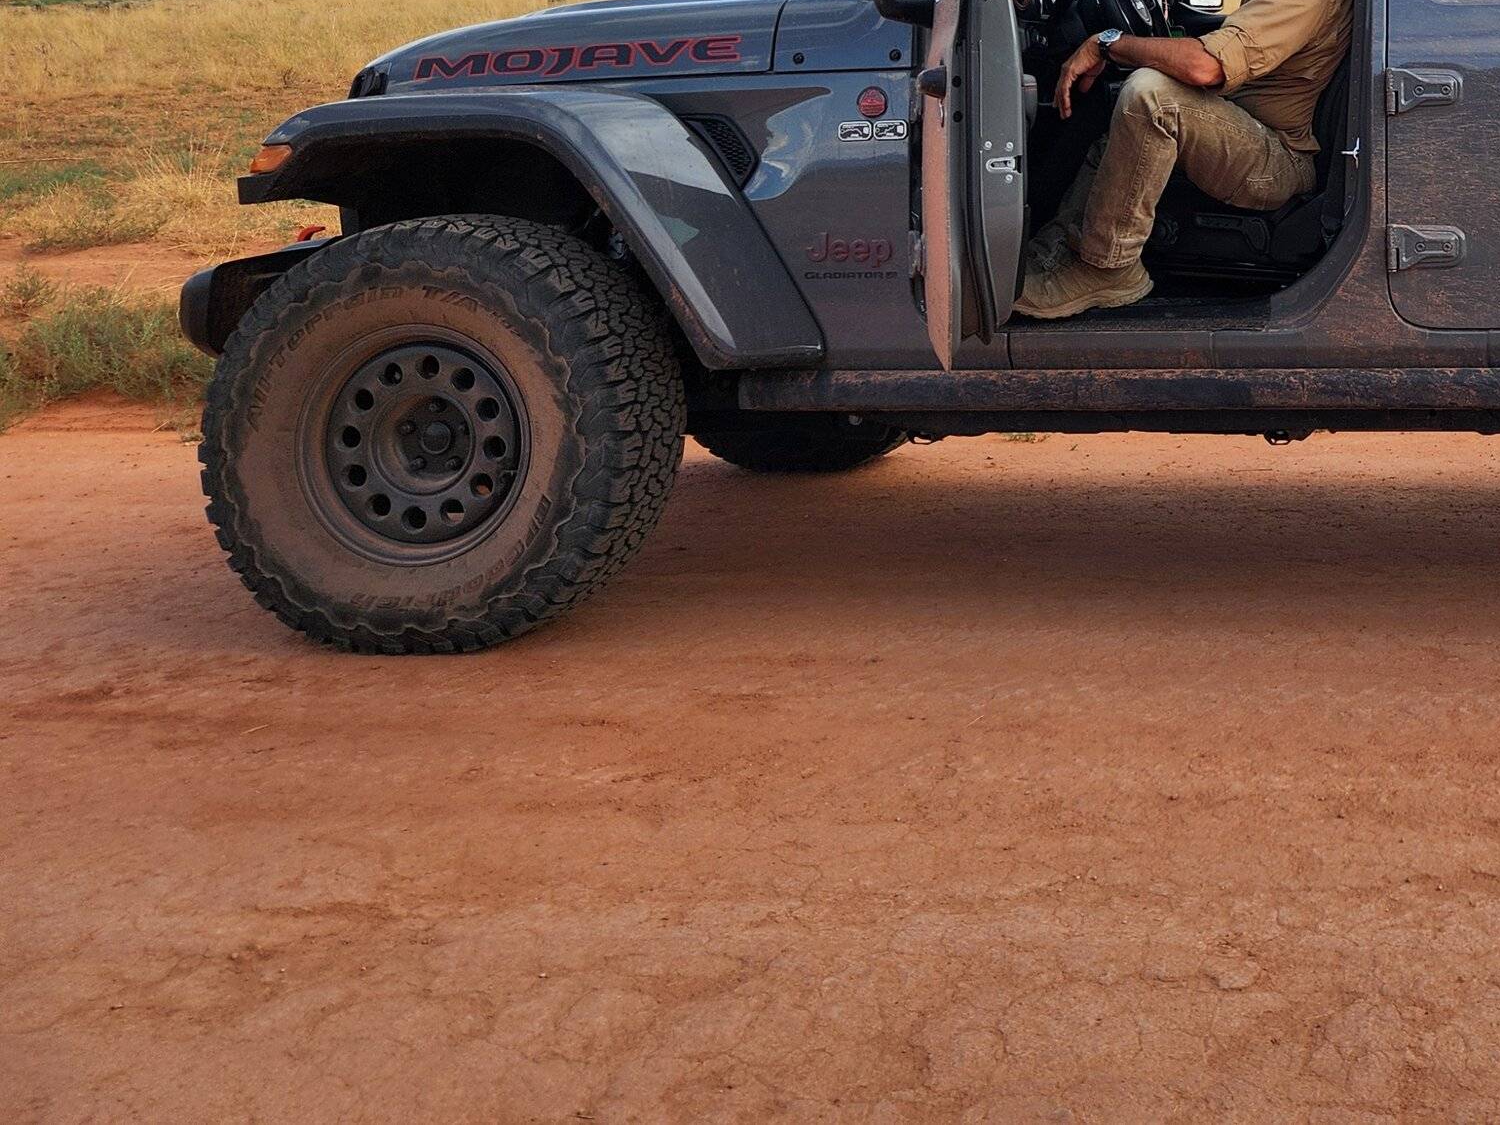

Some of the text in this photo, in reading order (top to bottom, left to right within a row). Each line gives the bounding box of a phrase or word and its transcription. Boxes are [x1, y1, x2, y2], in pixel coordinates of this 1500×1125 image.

[413, 35, 741, 81] MOJAVE
[805, 231, 893, 268] Jeep
[804, 271, 884, 280] GLADIATOR
